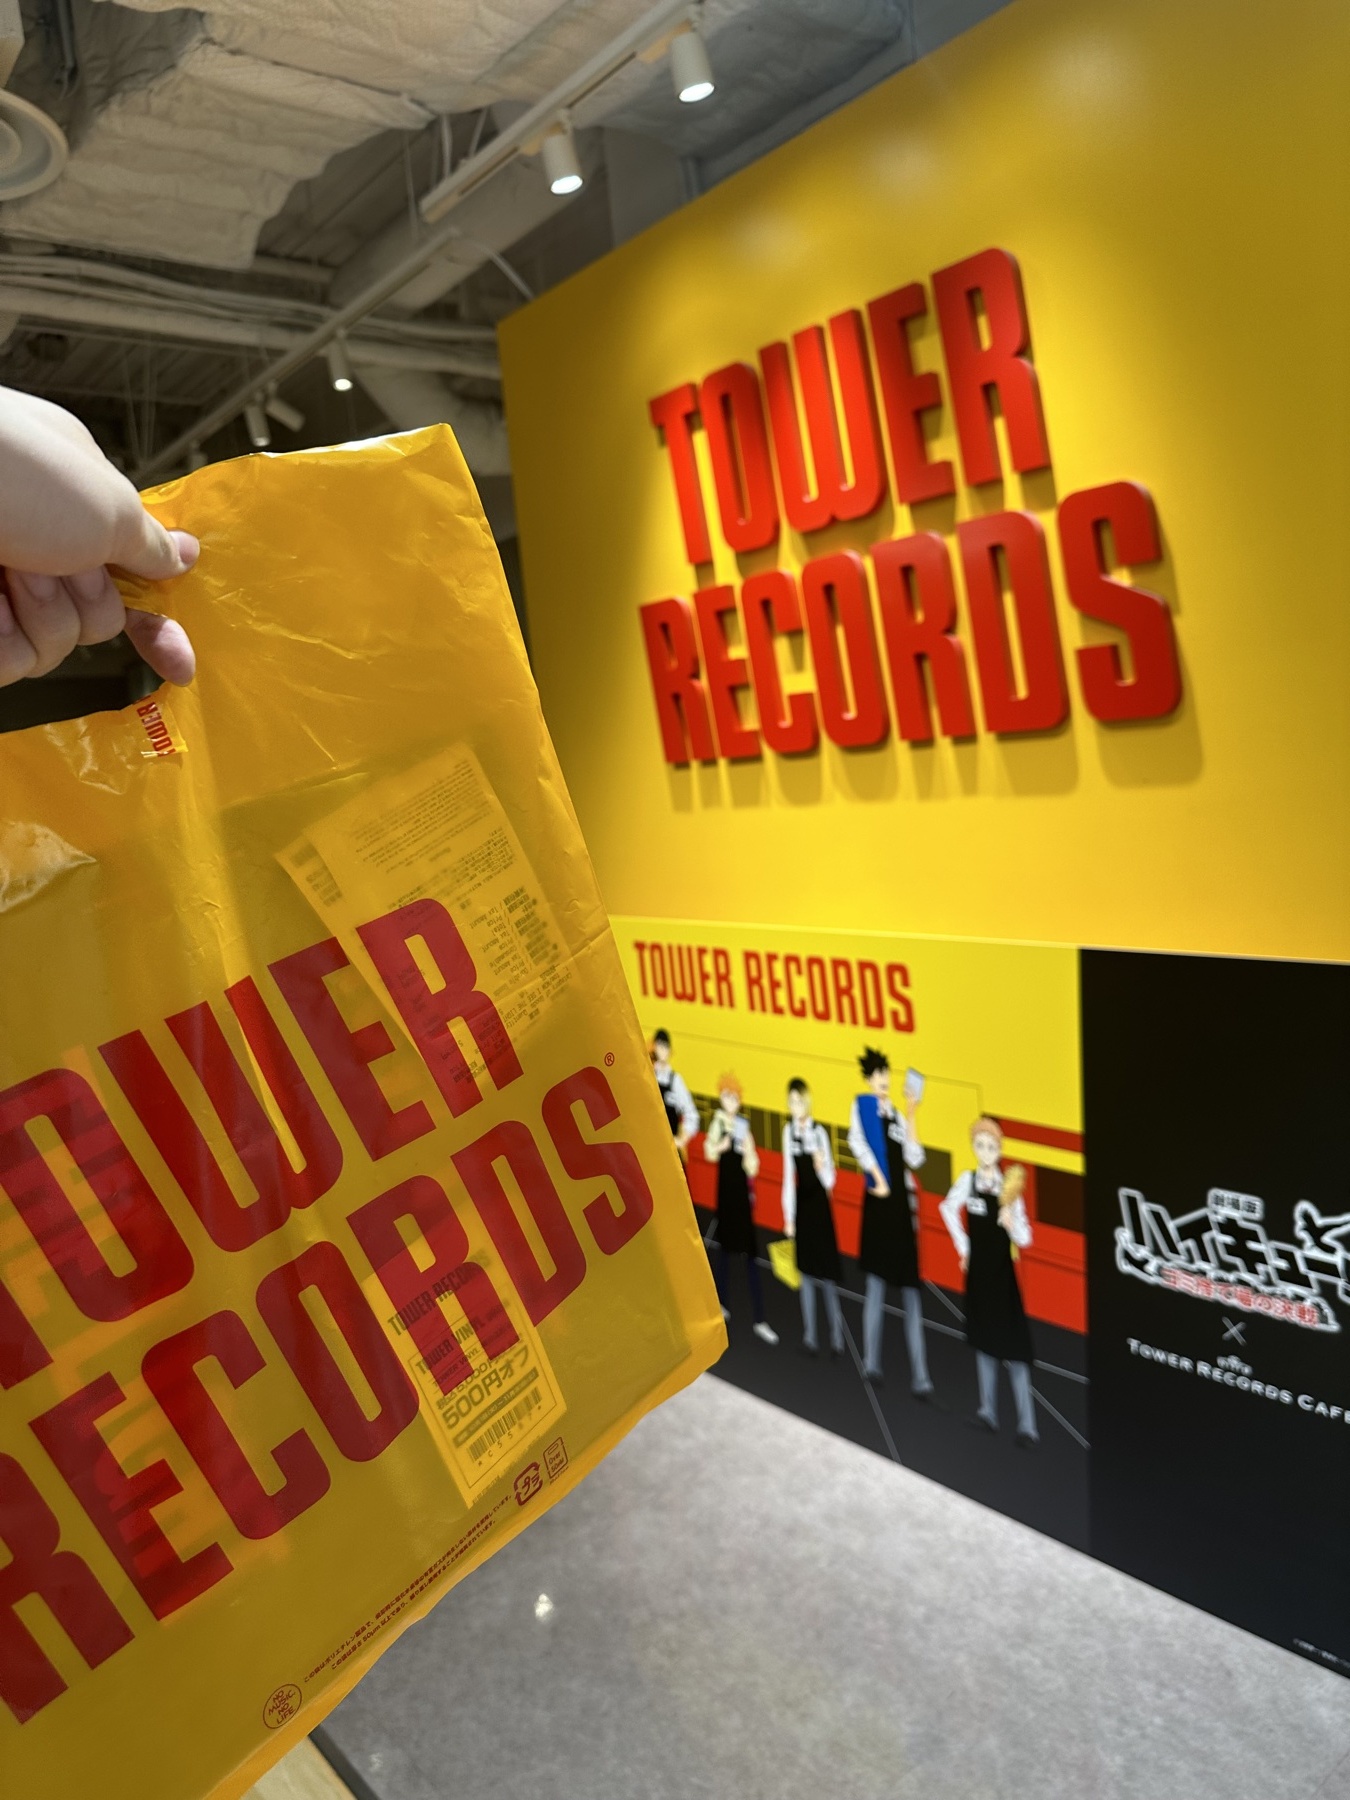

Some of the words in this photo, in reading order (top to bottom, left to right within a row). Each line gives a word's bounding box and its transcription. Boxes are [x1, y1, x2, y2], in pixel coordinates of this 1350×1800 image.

[648, 247, 1052, 566] TOWER
[639, 480, 1184, 766] RECORDS
[633, 940, 736, 1010] TOWER
[743, 949, 916, 1034] RECORDS
[387, 1288, 436, 1337] TOWER
[415, 1339, 454, 1376] TOWER
[442, 1344, 530, 1430] 500円オフ
[1127, 1337, 1195, 1373] TOWER
[1196, 1360, 1294, 1405] RECORDS
[0, 1065, 654, 1726] RECORDS
[522, 1471, 541, 1495] プラ
[272, 1690, 285, 1704] NO
[278, 1702, 290, 1715] NO
